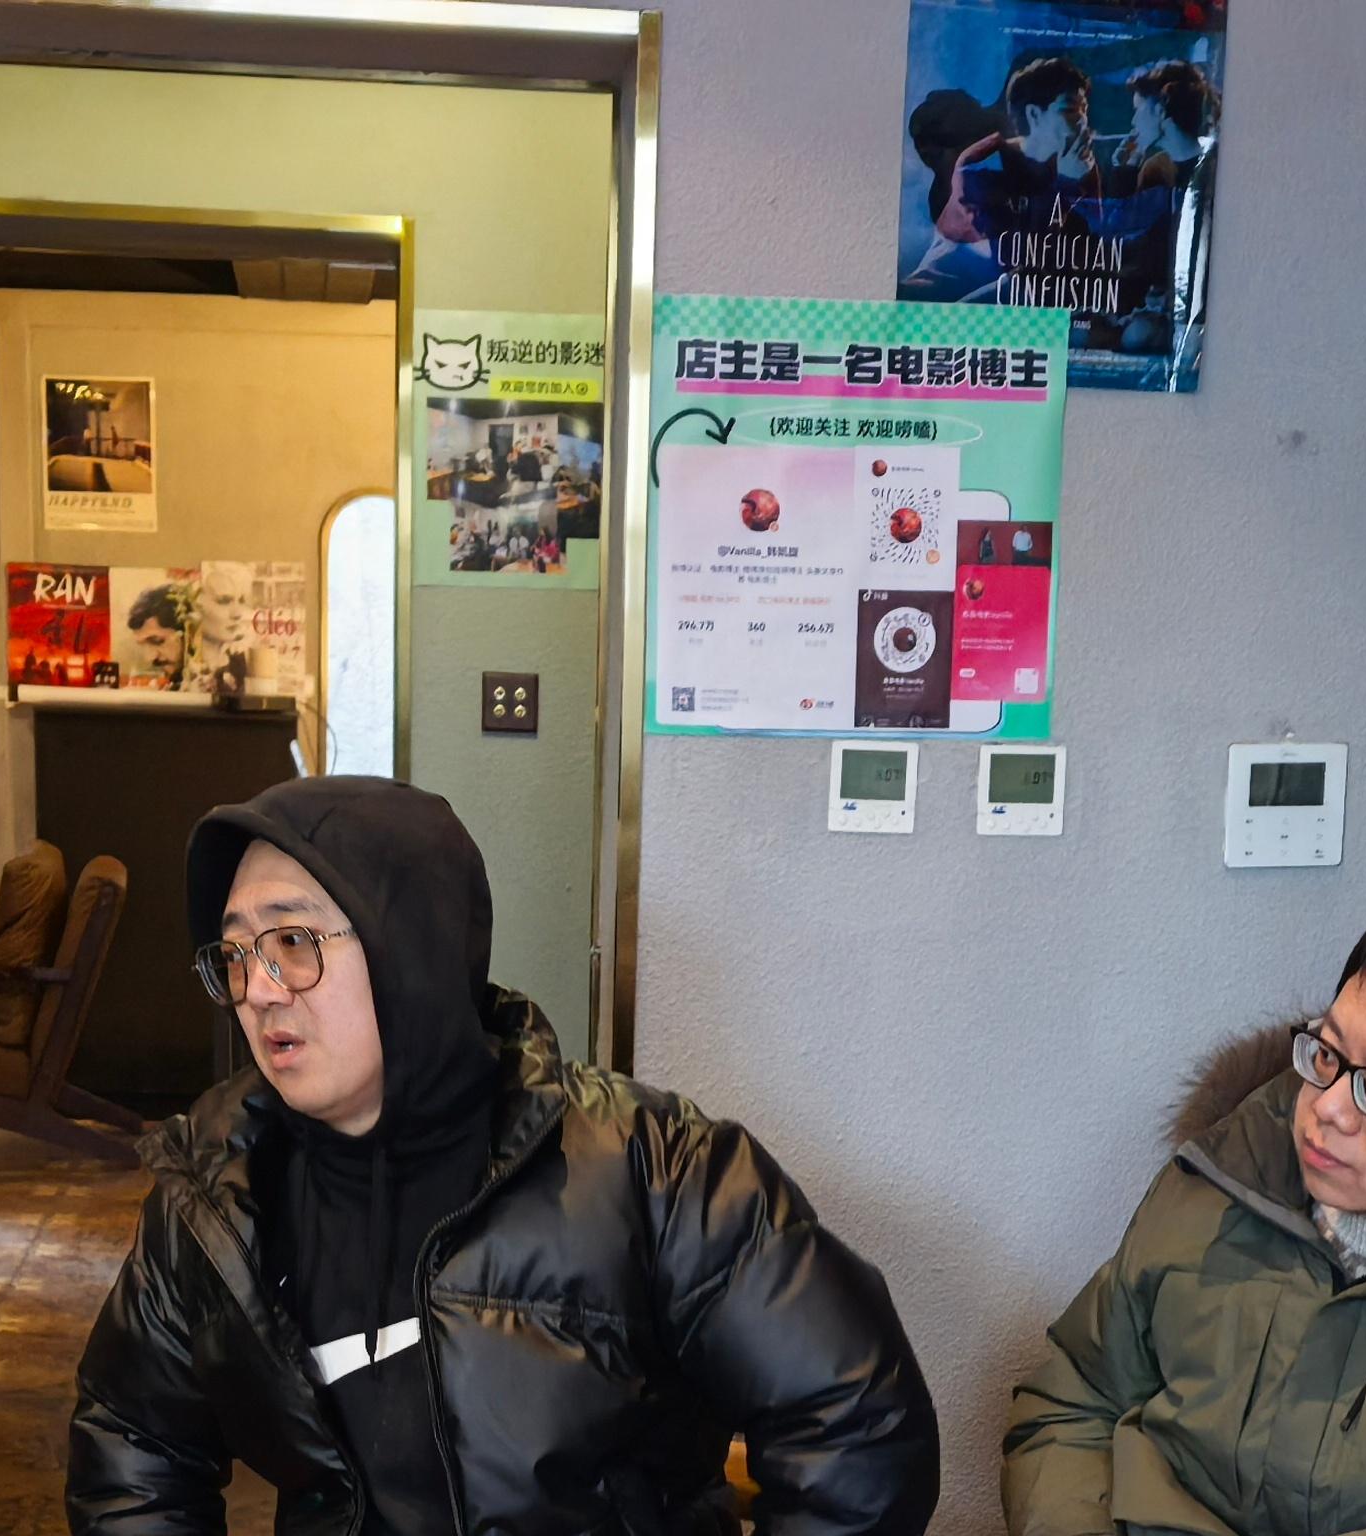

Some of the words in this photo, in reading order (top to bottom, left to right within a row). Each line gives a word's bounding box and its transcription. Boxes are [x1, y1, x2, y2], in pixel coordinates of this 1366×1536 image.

[1049, 191, 1064, 228] A
[997, 231, 1124, 273] CONFUCIAN
[996, 272, 1120, 314] CONFUSION
[487, 339, 605, 366] 叛逆的影迷
[675, 339, 1049, 388] 店主是一名电影博主
[33, 572, 96, 606] RAN
[252, 608, 297, 637] Cléo
